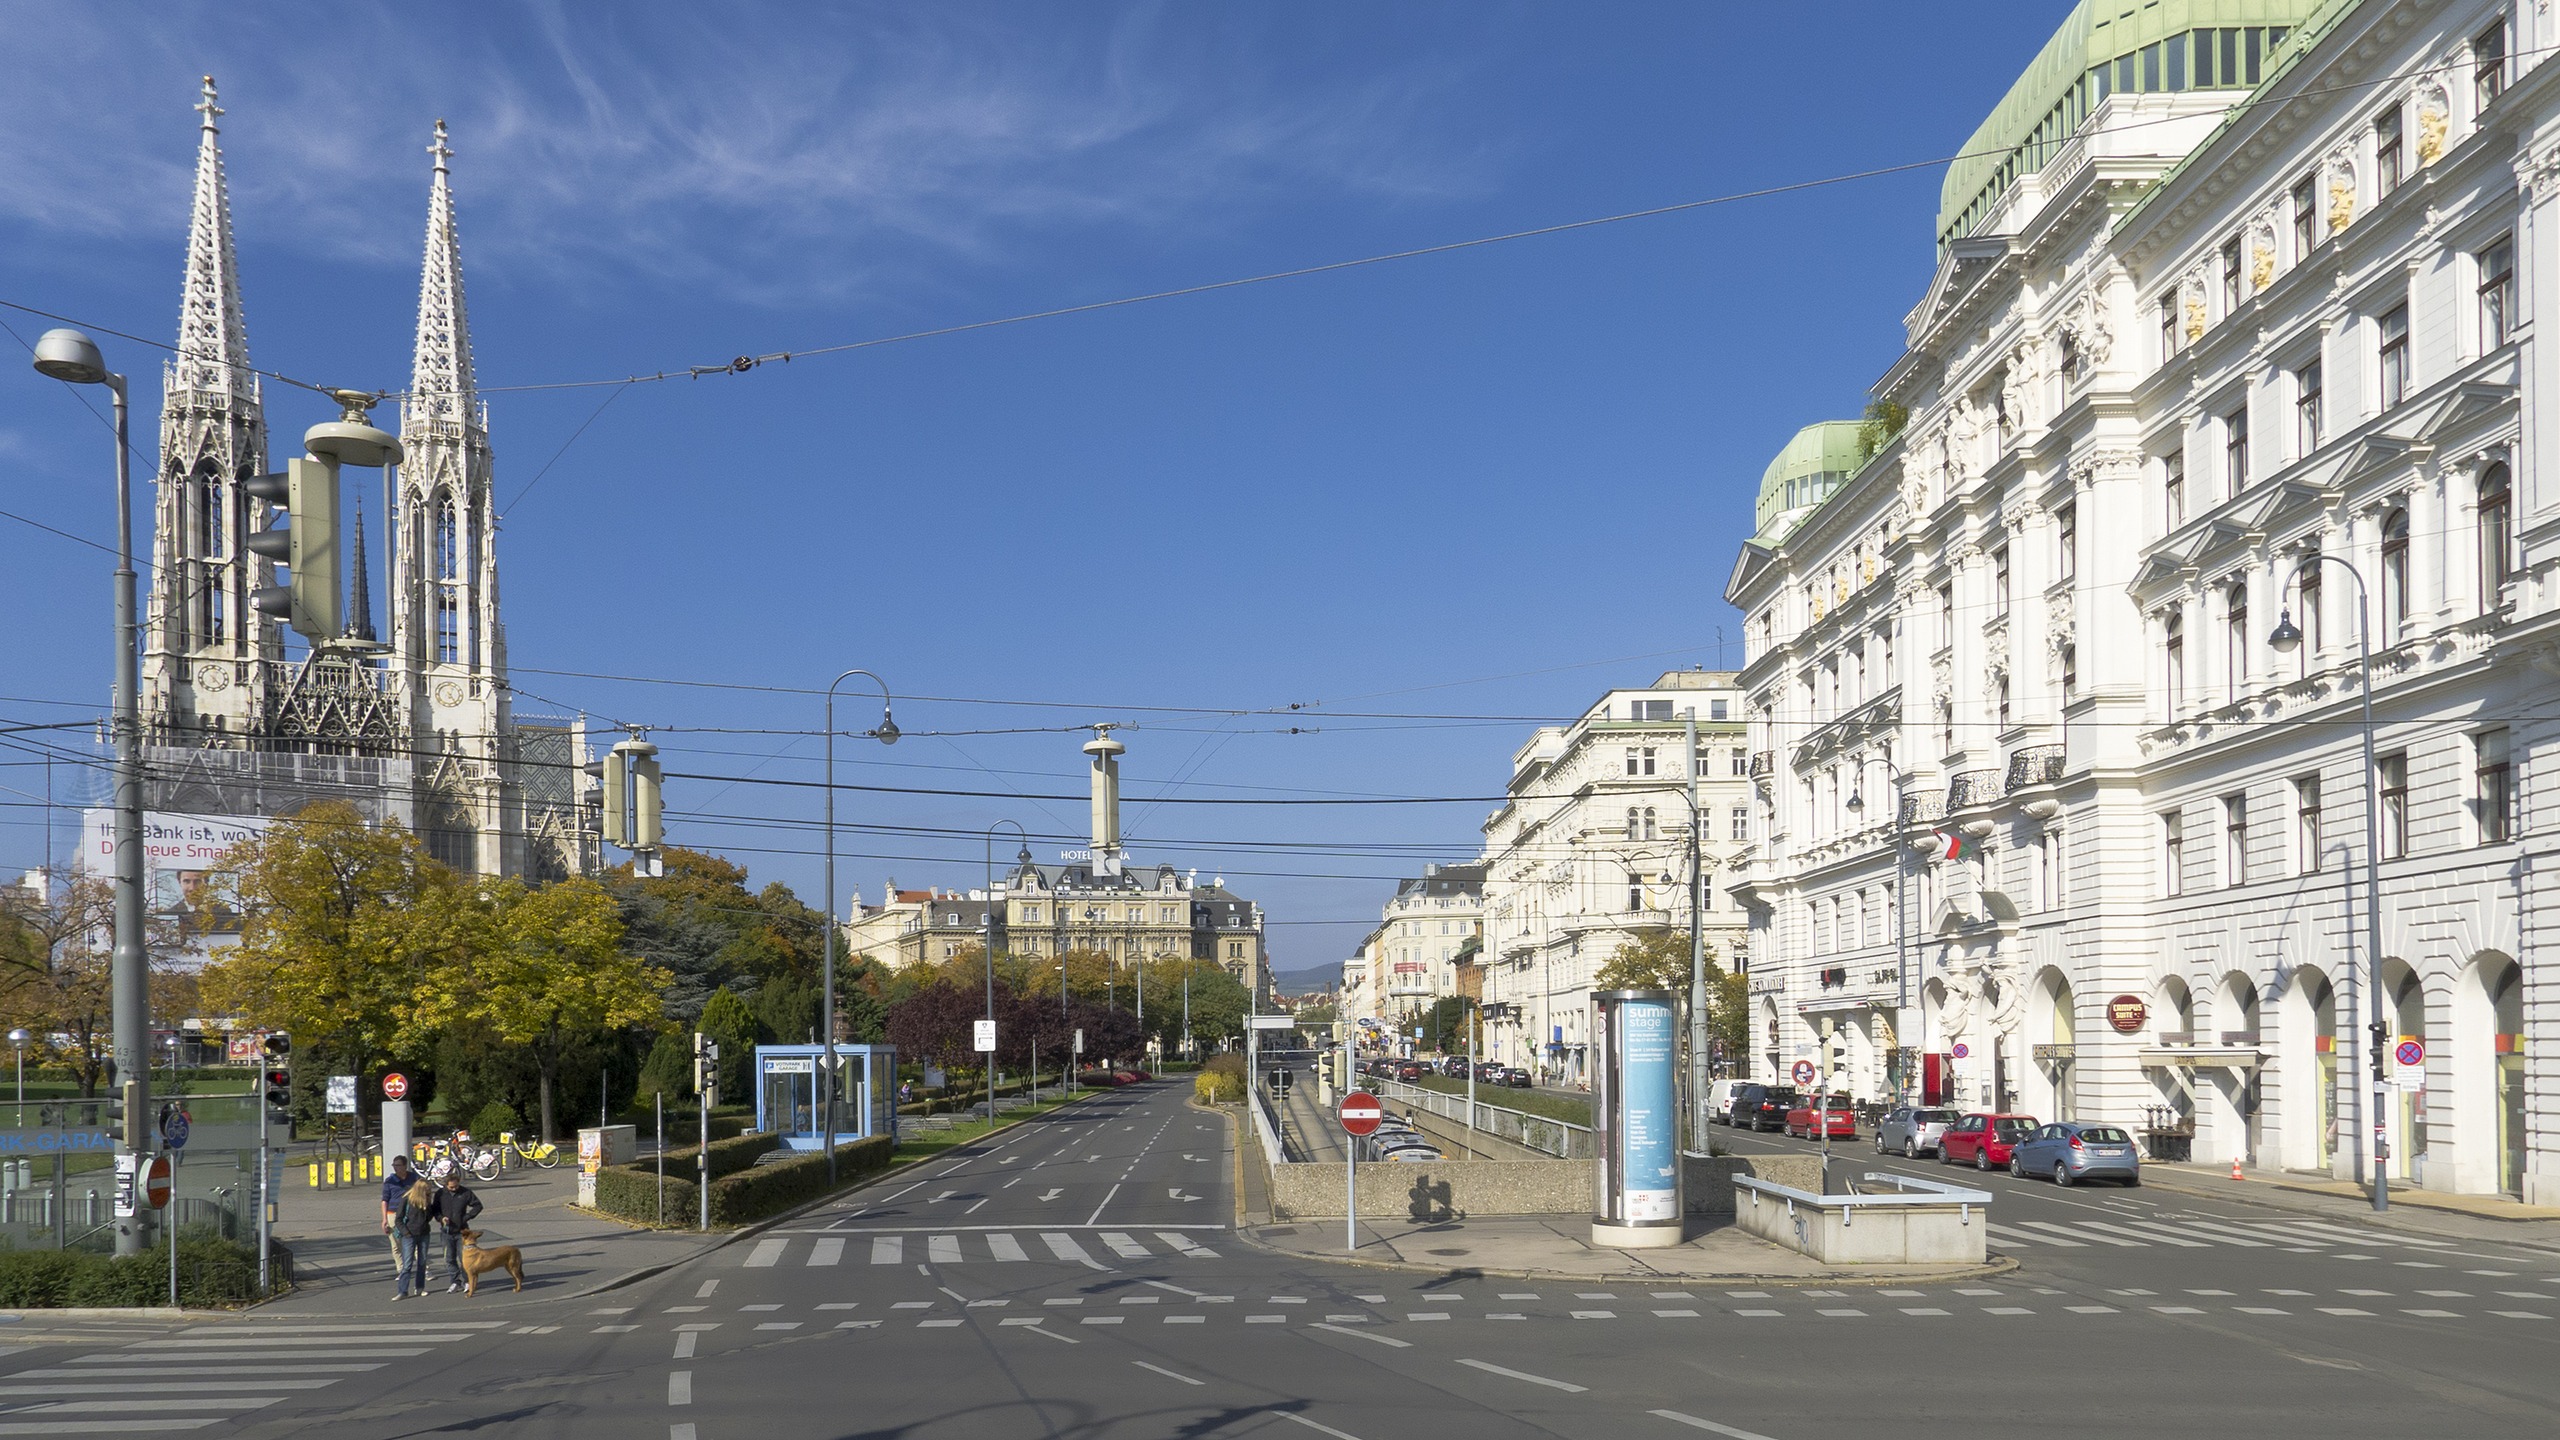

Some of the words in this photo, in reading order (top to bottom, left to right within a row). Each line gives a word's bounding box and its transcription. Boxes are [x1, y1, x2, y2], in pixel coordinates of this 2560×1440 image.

[143, 825, 184, 839] Bank
[190, 827, 215, 843] ist,
[222, 831, 246, 841] wo
[1061, 850, 1092, 860] HOTEL
[2113, 1004, 2142, 1012] CAMPUS
[1630, 1018, 1661, 1030] stage
